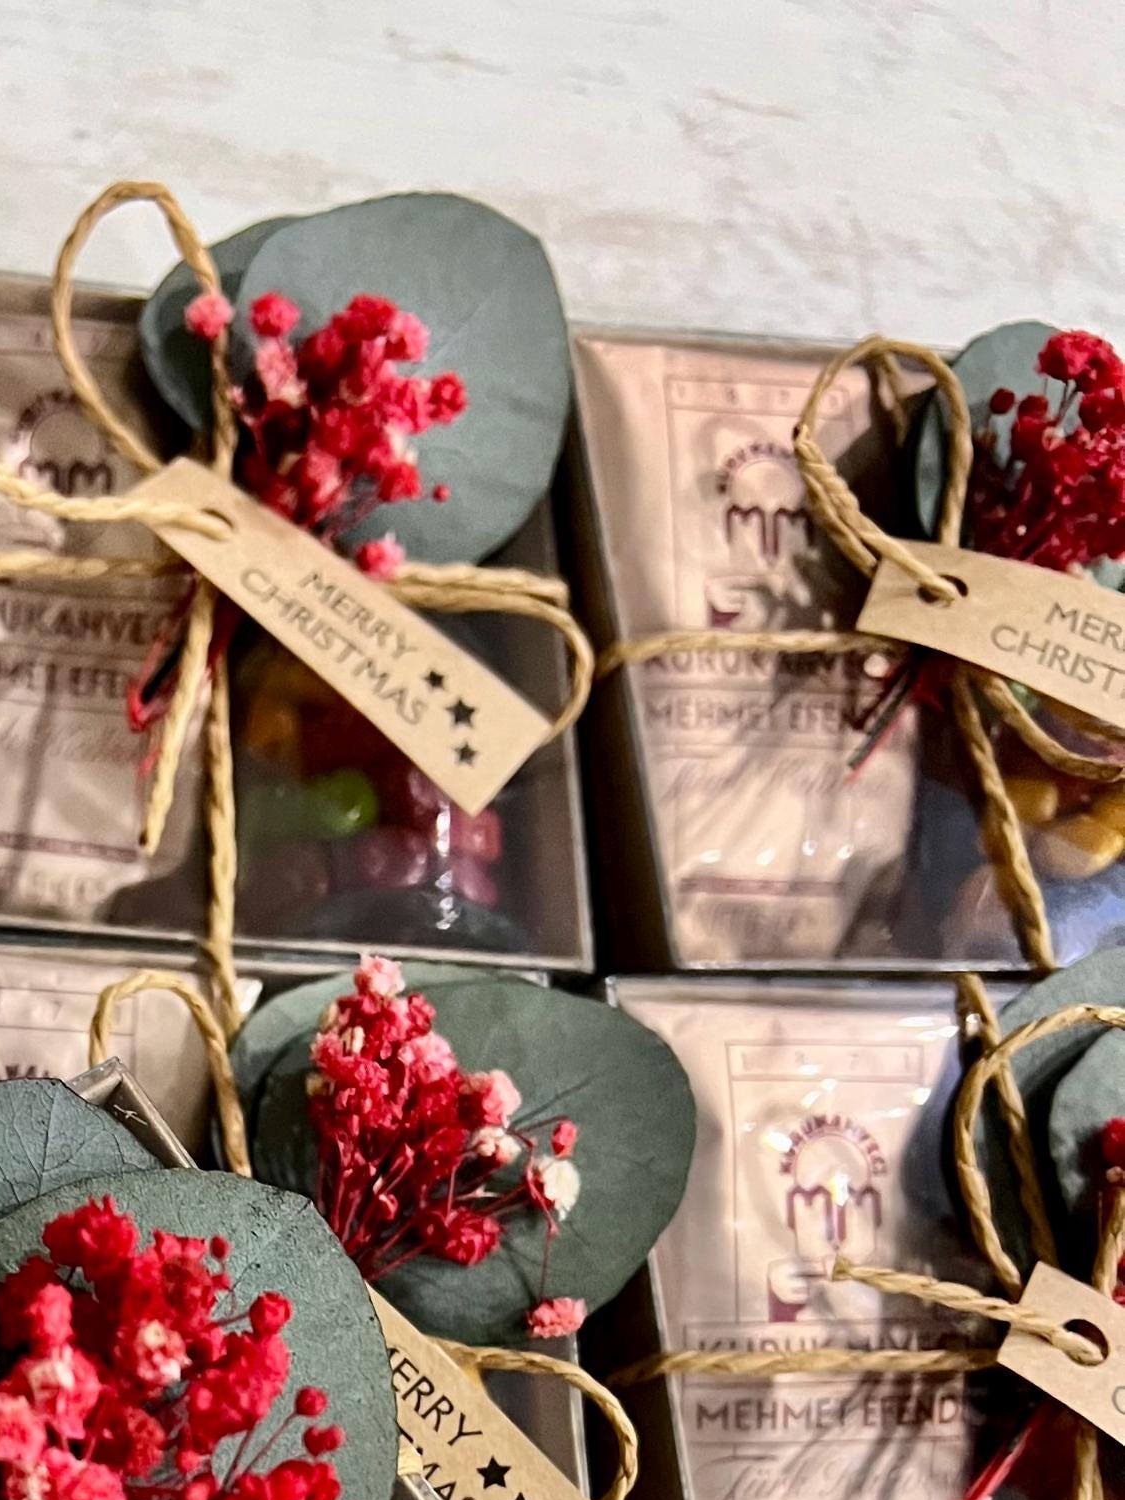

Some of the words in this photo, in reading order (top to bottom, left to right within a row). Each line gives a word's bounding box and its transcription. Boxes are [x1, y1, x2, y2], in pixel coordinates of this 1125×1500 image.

[239, 567, 429, 726] CHRISTMAS
[299, 569, 418, 660] MERRY
[1044, 602, 1125, 653] MER
[990, 624, 1125, 700] CHRIST
[387, 1347, 483, 1446] ERRY
[696, 1396, 851, 1431] MEHMET
